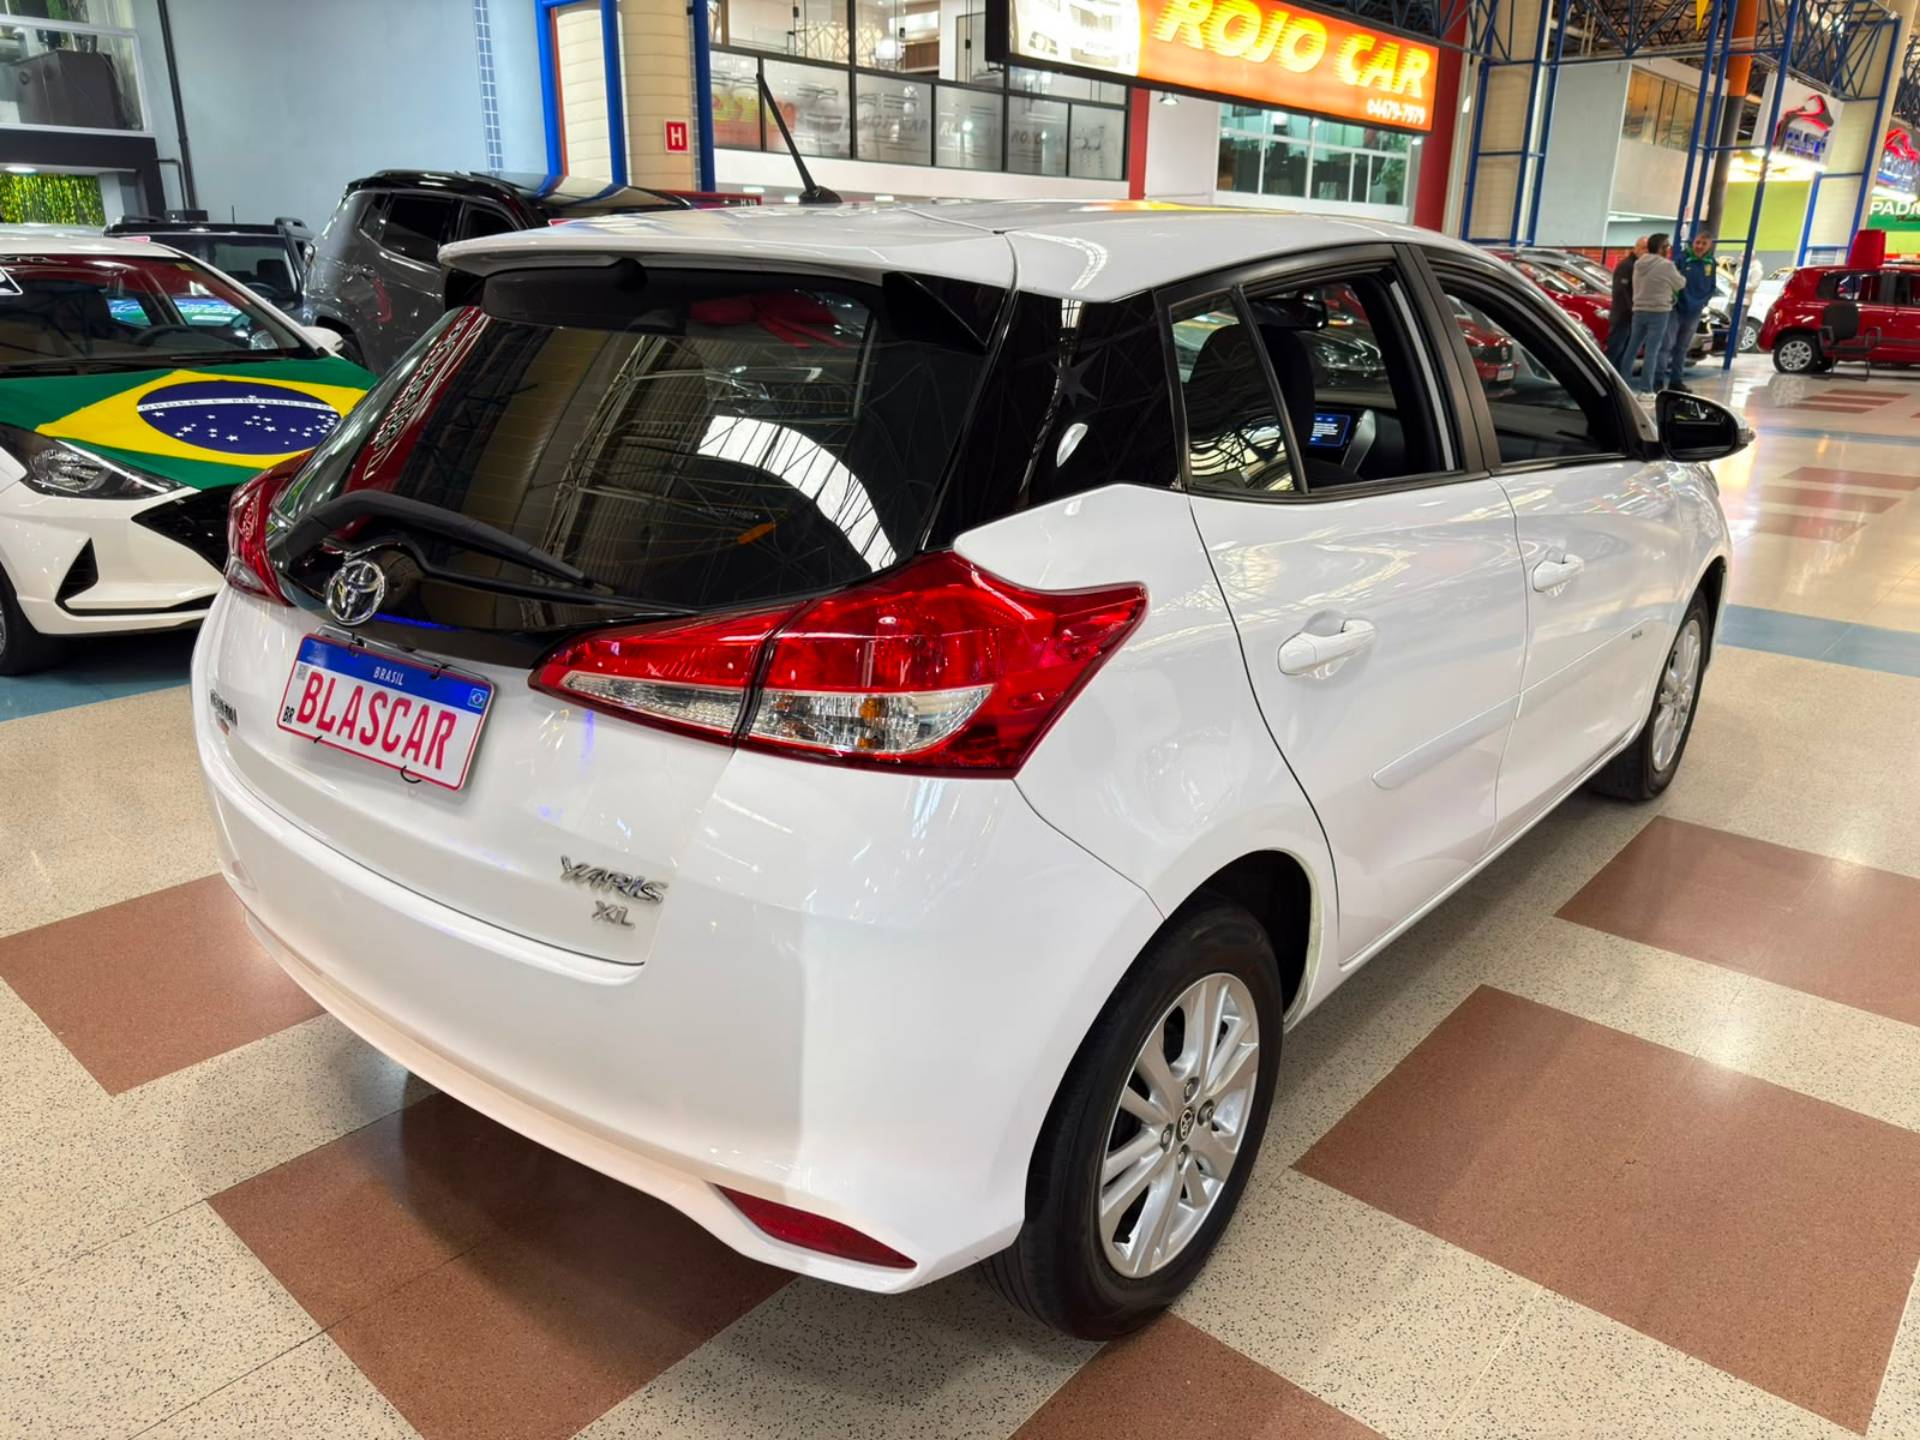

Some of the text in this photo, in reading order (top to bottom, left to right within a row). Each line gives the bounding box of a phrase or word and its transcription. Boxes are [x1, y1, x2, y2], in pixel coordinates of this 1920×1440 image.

[1152, 0, 1430, 99] ROJO CAR
[671, 126, 683, 146] H
[373, 667, 404, 686] BRASIL
[284, 705, 295, 724] BR
[297, 672, 457, 770] BLASCAR
[560, 855, 668, 903] YARIS
[592, 900, 635, 929] XL
